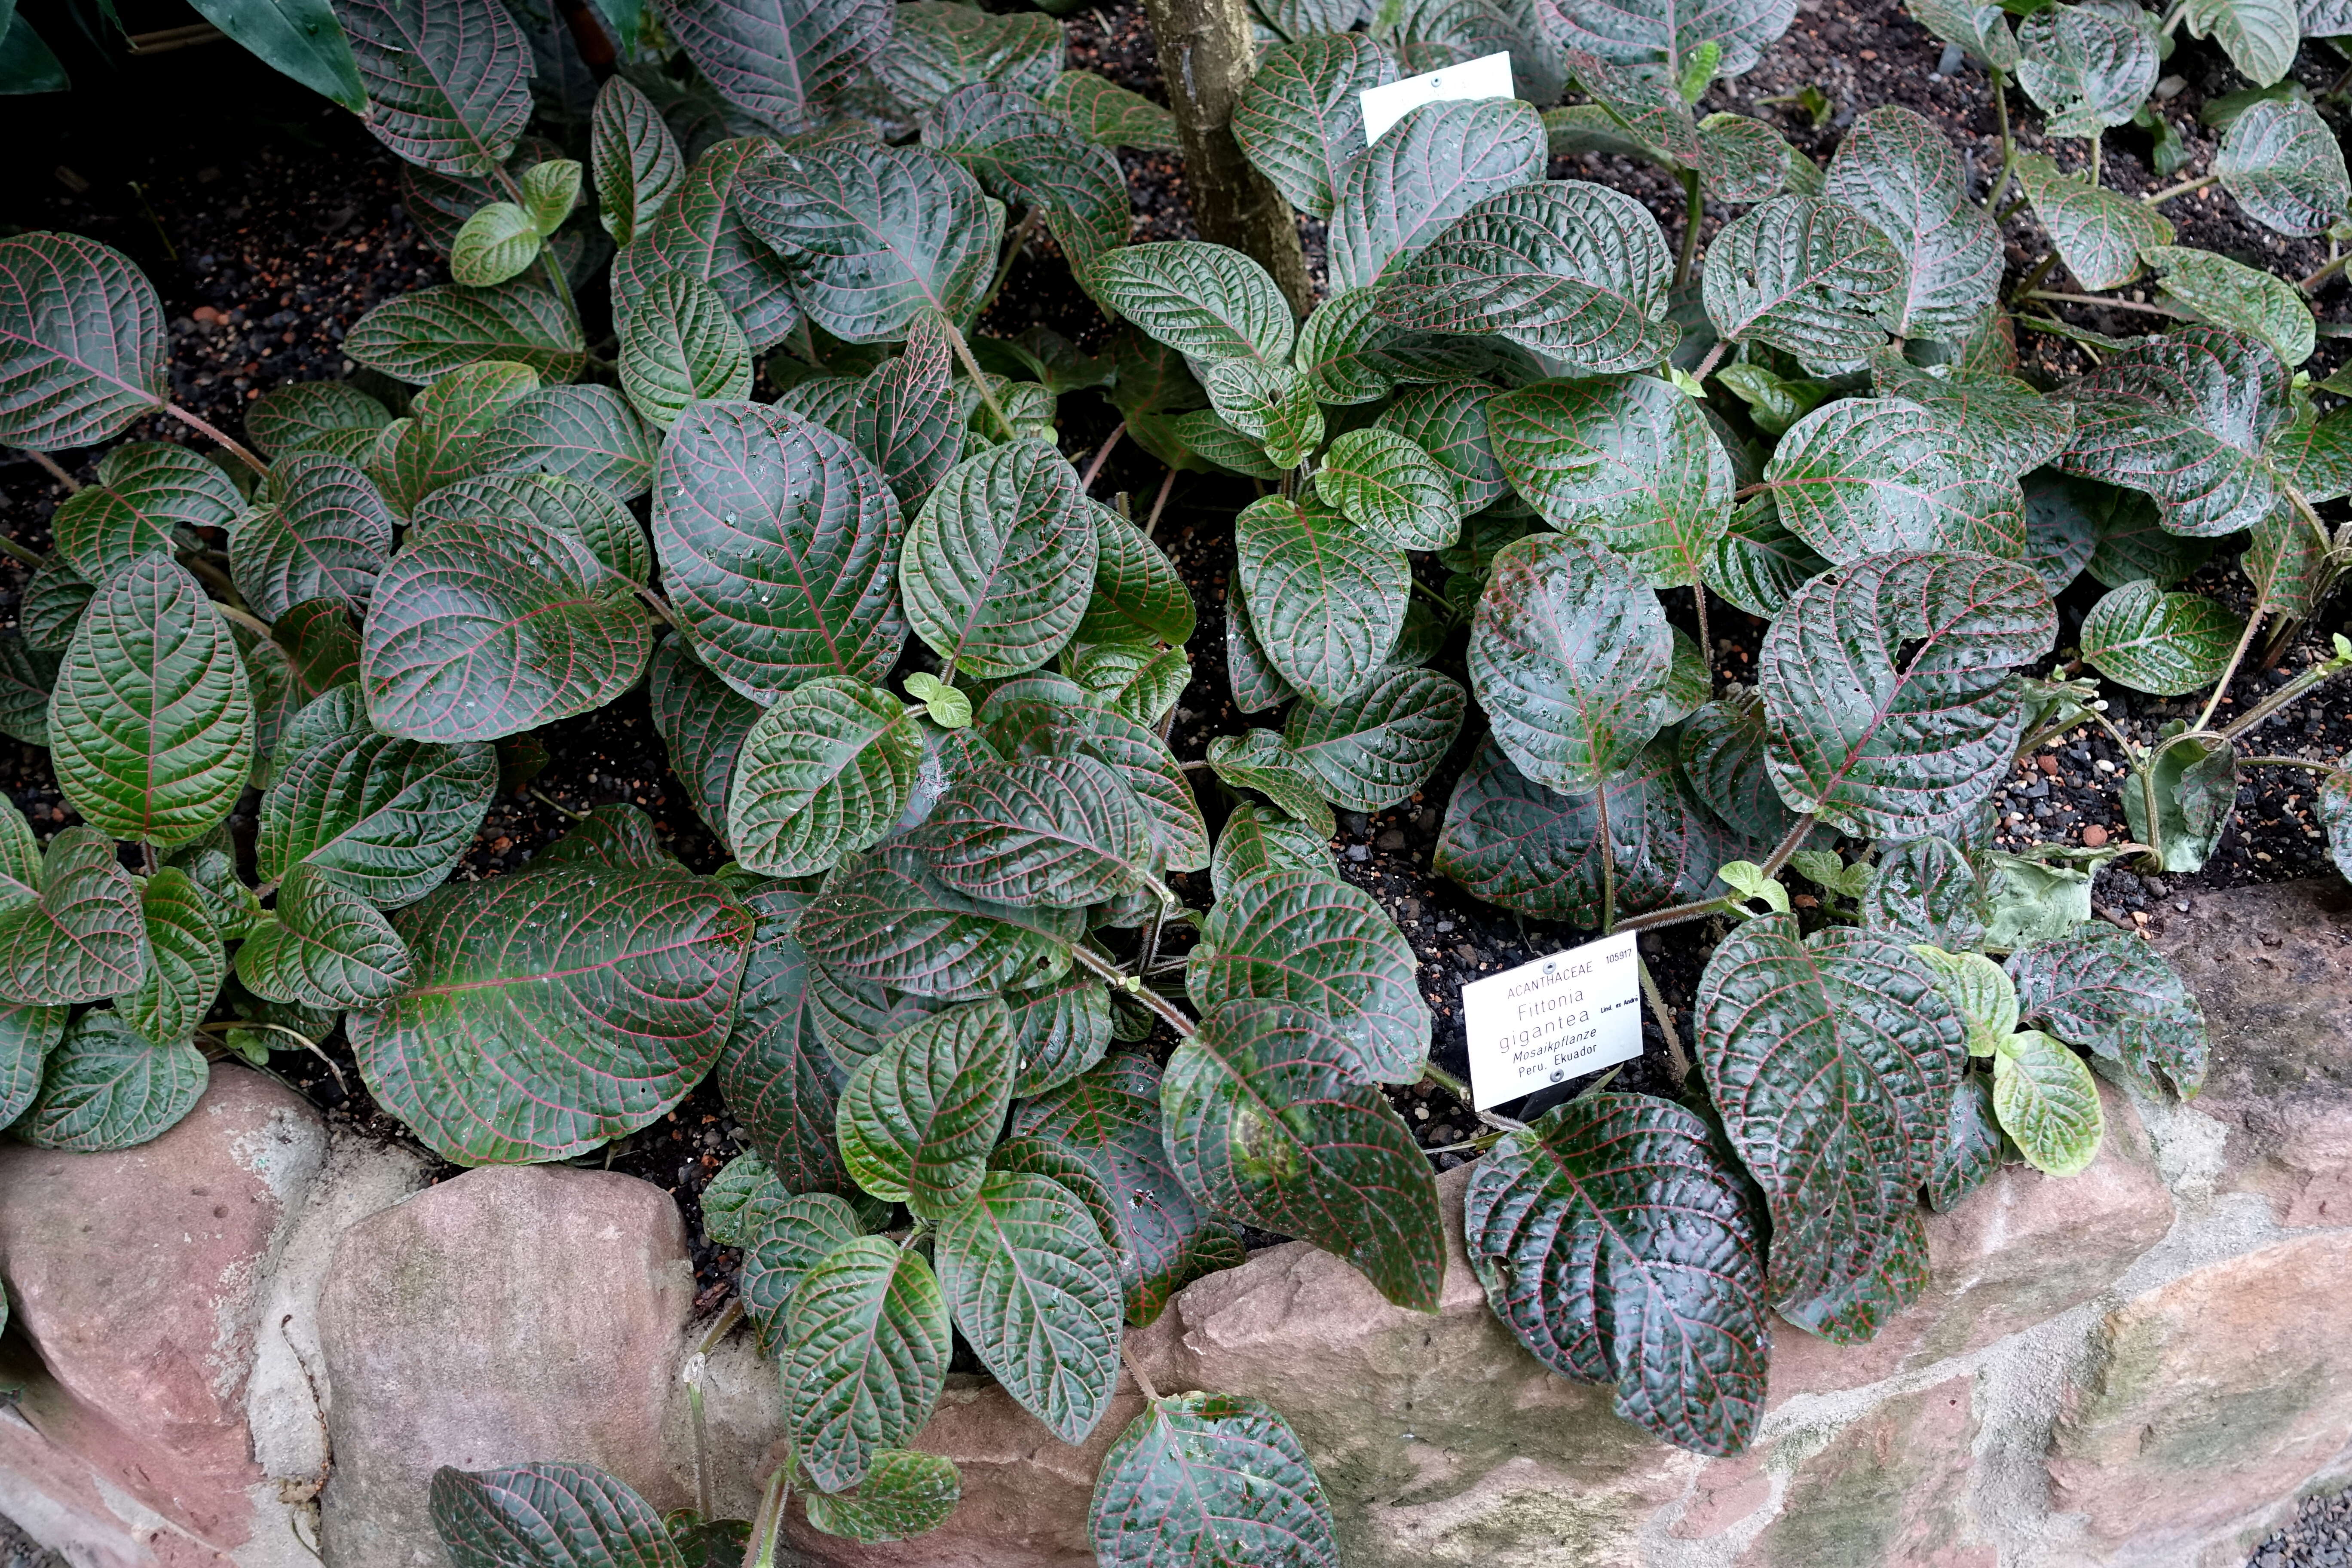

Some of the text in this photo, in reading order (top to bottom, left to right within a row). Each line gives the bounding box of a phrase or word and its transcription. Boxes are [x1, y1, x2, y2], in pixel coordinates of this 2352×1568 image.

[1606, 949, 1632, 964] 105917
[1508, 961, 1593, 999] ACANTHACEAE
[1518, 989, 1583, 1021] Fittonia
[1500, 1011, 1589, 1054] gigantea
[1513, 1028, 1596, 1064] Mosaikpflanze
[1554, 1044, 1597, 1066] Ekuador
